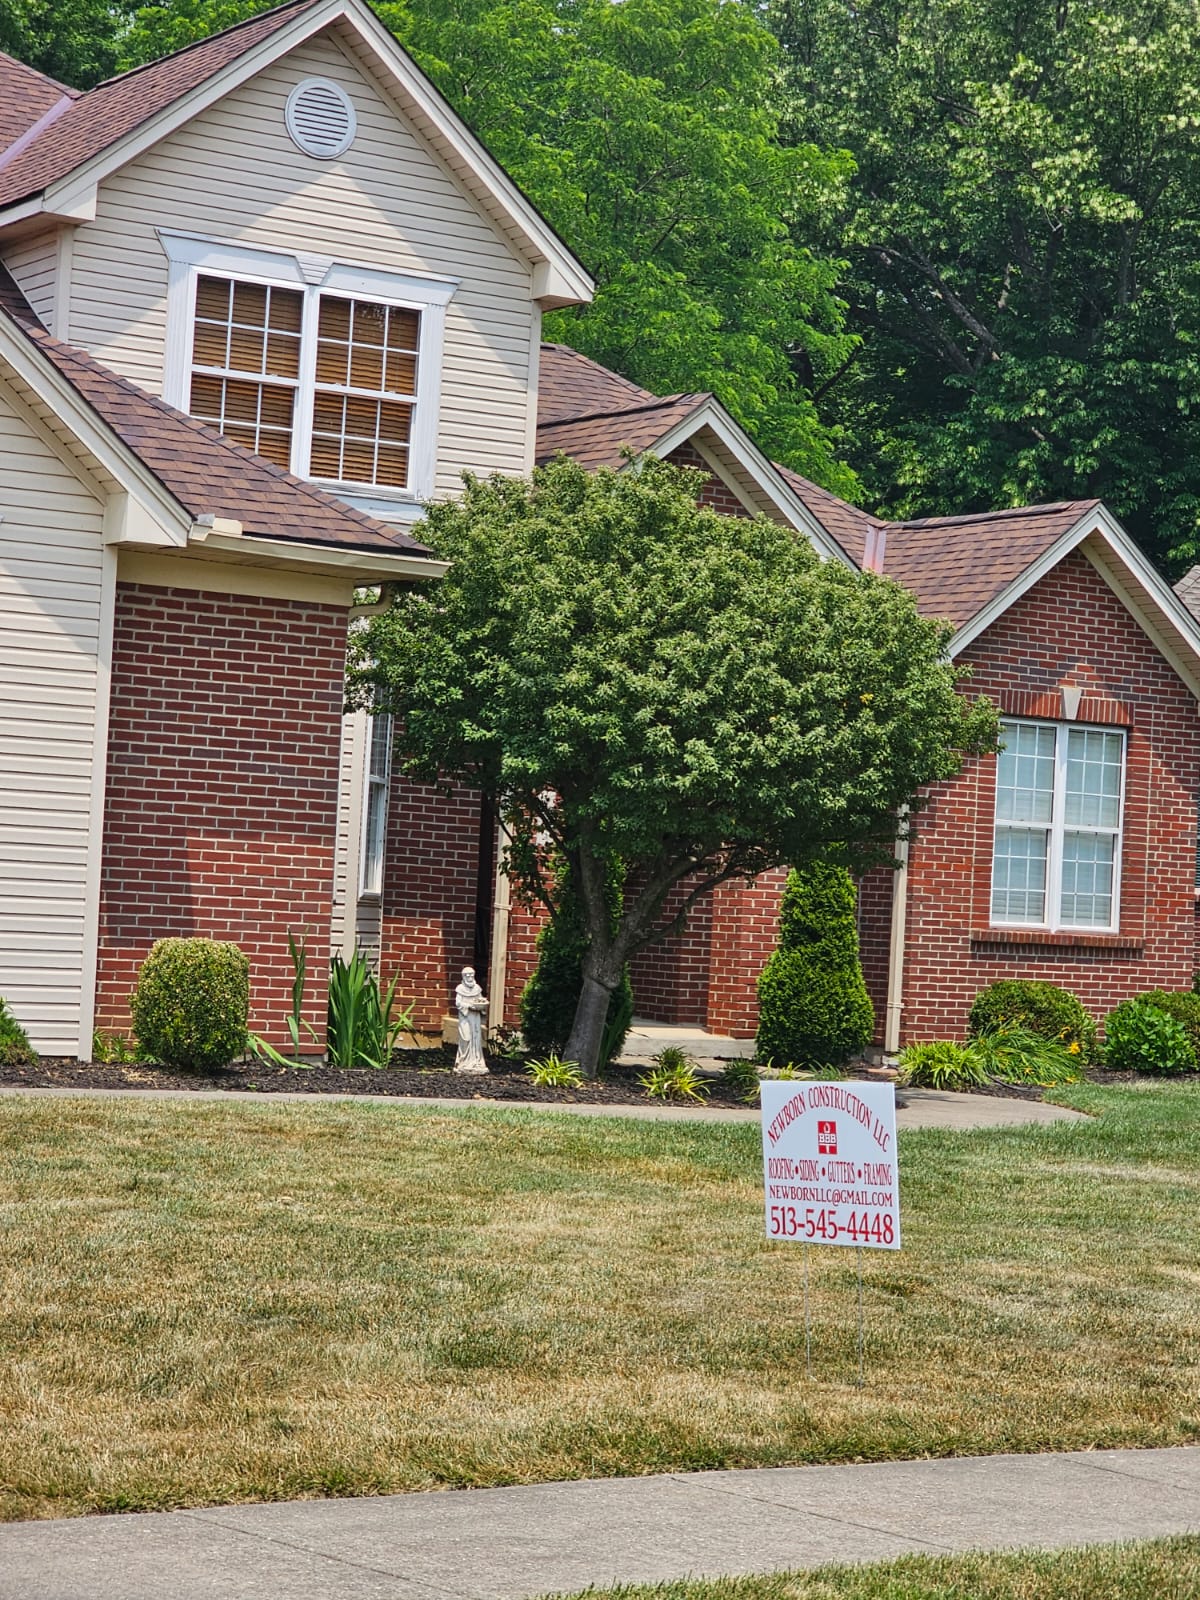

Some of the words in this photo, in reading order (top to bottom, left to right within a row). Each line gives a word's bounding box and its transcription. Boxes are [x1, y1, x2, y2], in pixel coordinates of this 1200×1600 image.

[768, 1091, 807, 1148] NEWBORN
[808, 1085, 872, 1131] CONSTRUCTION
[873, 1118, 890, 1153] LLC
[819, 1133, 837, 1144] BBB
[768, 1158, 794, 1180] ROOFING
[799, 1159, 819, 1181] SIDING
[827, 1161, 855, 1184] GUTTERS
[863, 1163, 892, 1186] FRAMING
[769, 1185, 893, 1207] NEWBORNLLC@GMAIL.COM
[770, 1206, 894, 1244] 513-545-4448
